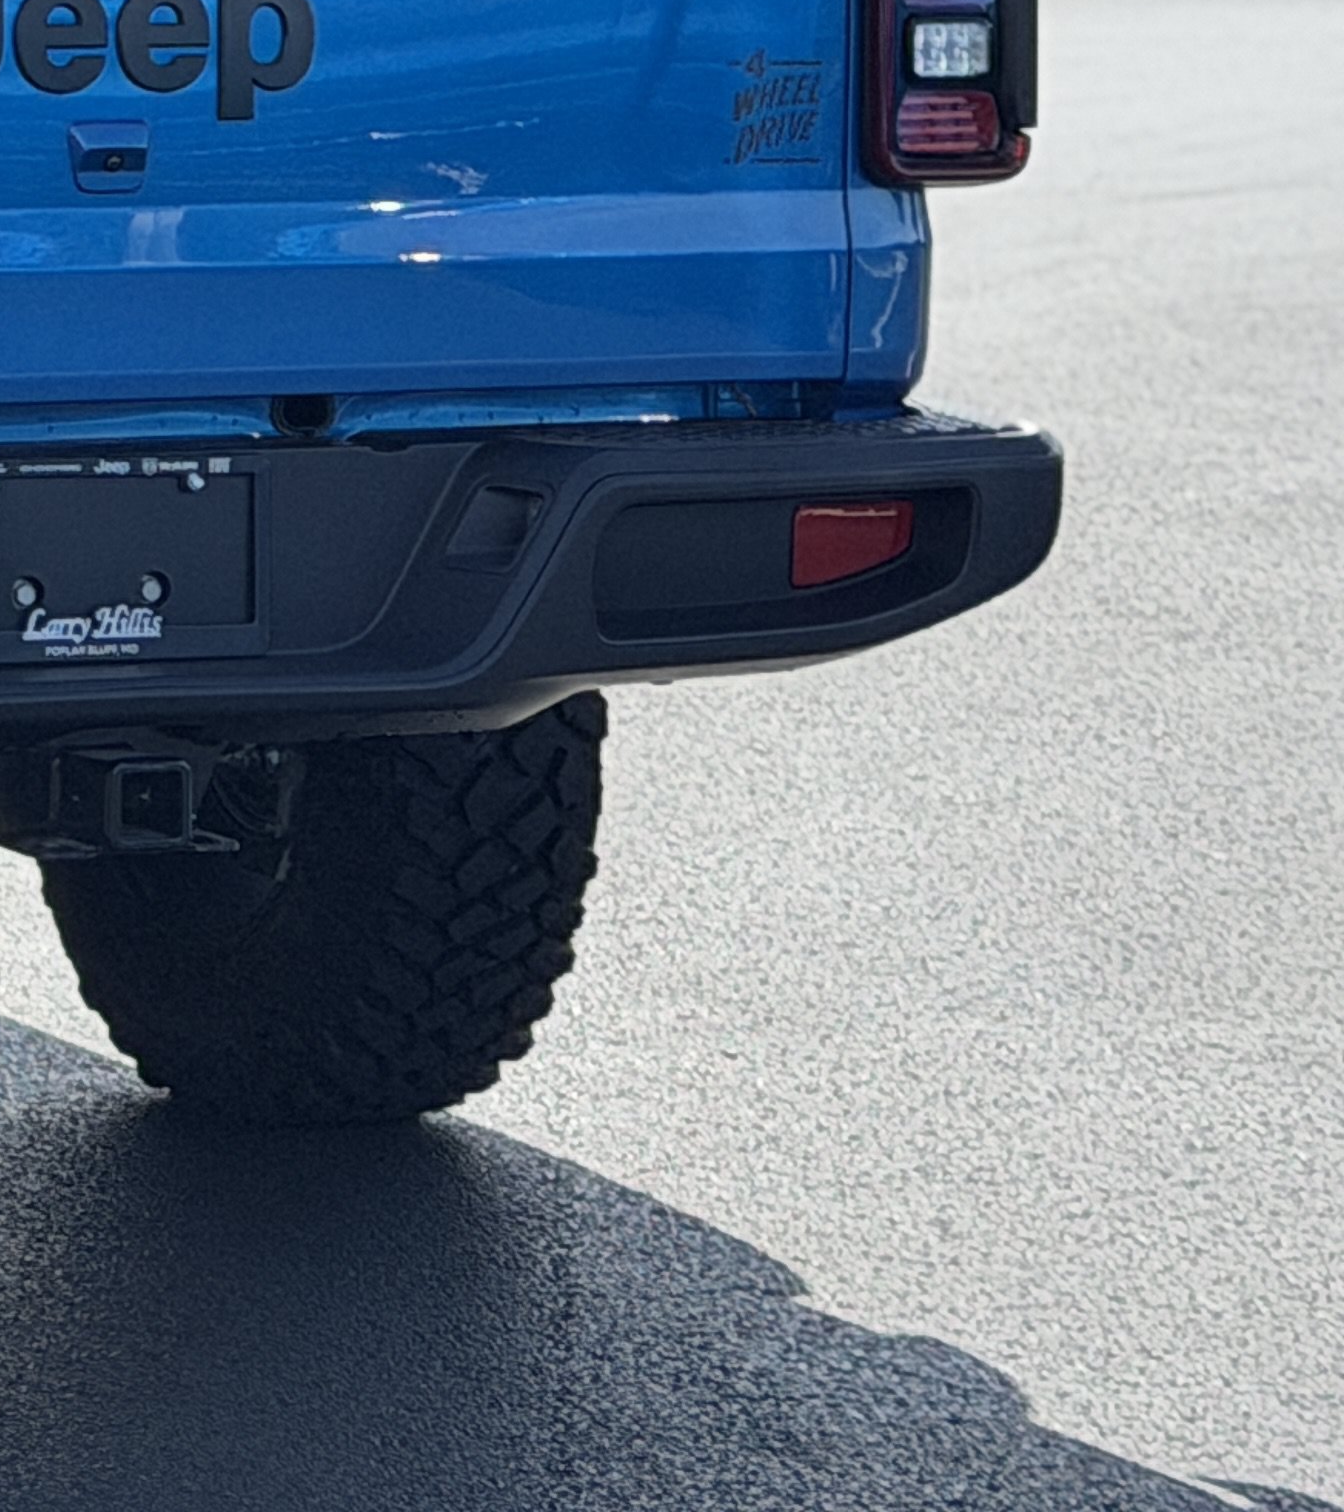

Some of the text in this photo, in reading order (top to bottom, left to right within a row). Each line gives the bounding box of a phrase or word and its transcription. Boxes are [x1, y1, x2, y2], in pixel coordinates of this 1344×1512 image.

[745, 48, 765, 78] 4
[732, 72, 820, 121] WHEEL
[733, 110, 819, 165] DRIVE
[22, 604, 163, 644] Larry Hillis
